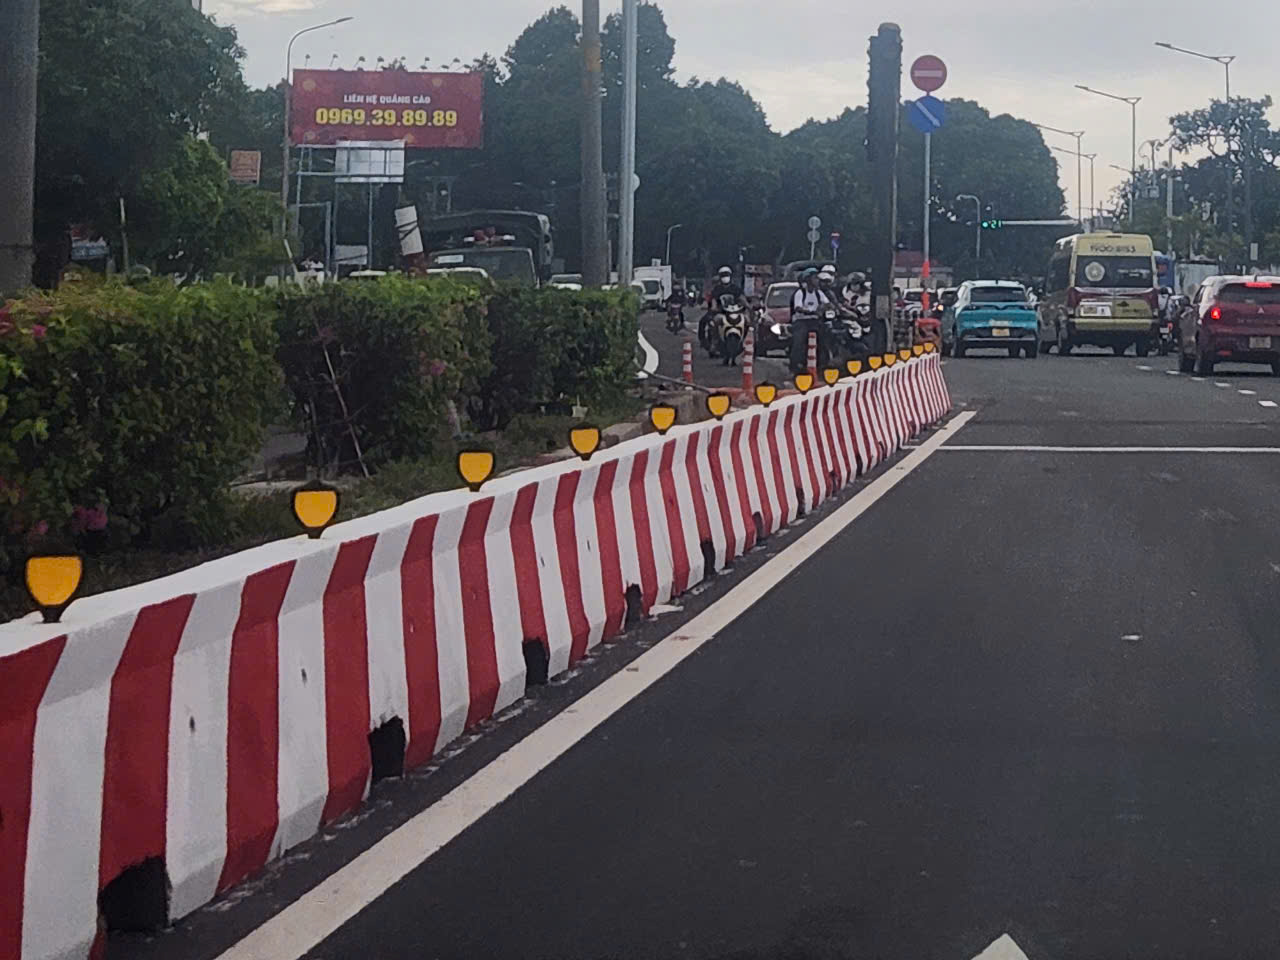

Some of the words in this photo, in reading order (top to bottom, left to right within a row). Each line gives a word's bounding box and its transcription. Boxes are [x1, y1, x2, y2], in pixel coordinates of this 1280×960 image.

[343, 93, 364, 103] LIÊN
[365, 94, 377, 105] HỆ
[315, 107, 457, 127] 0969.39.89.89
